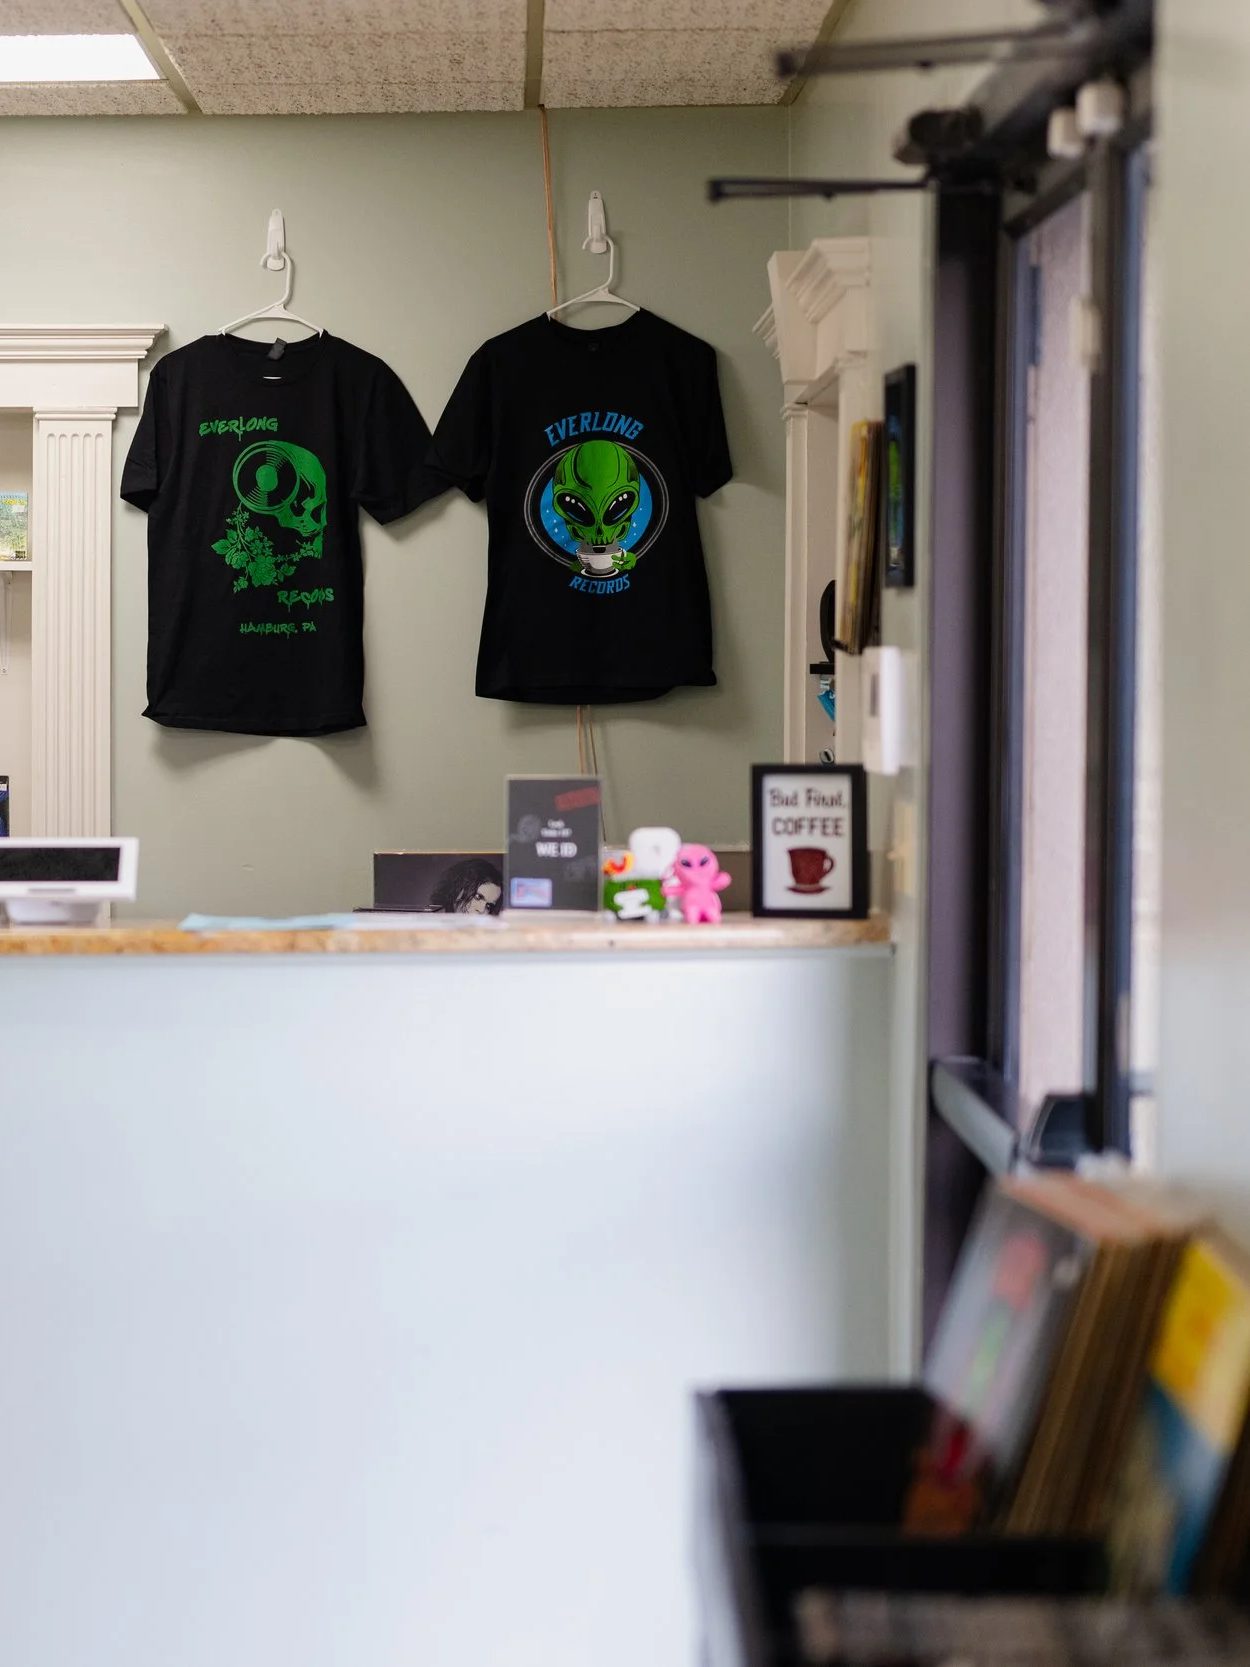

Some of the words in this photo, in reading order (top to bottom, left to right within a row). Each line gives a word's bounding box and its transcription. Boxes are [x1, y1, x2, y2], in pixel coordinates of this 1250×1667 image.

[198, 416, 279, 442] EVERLONG
[544, 411, 644, 447] EVERLONG
[569, 573, 631, 595] RECORDS
[302, 621, 317, 632] PA
[769, 788, 798, 808] But
[771, 817, 844, 838] COFFEE
[535, 841, 559, 858] WE
